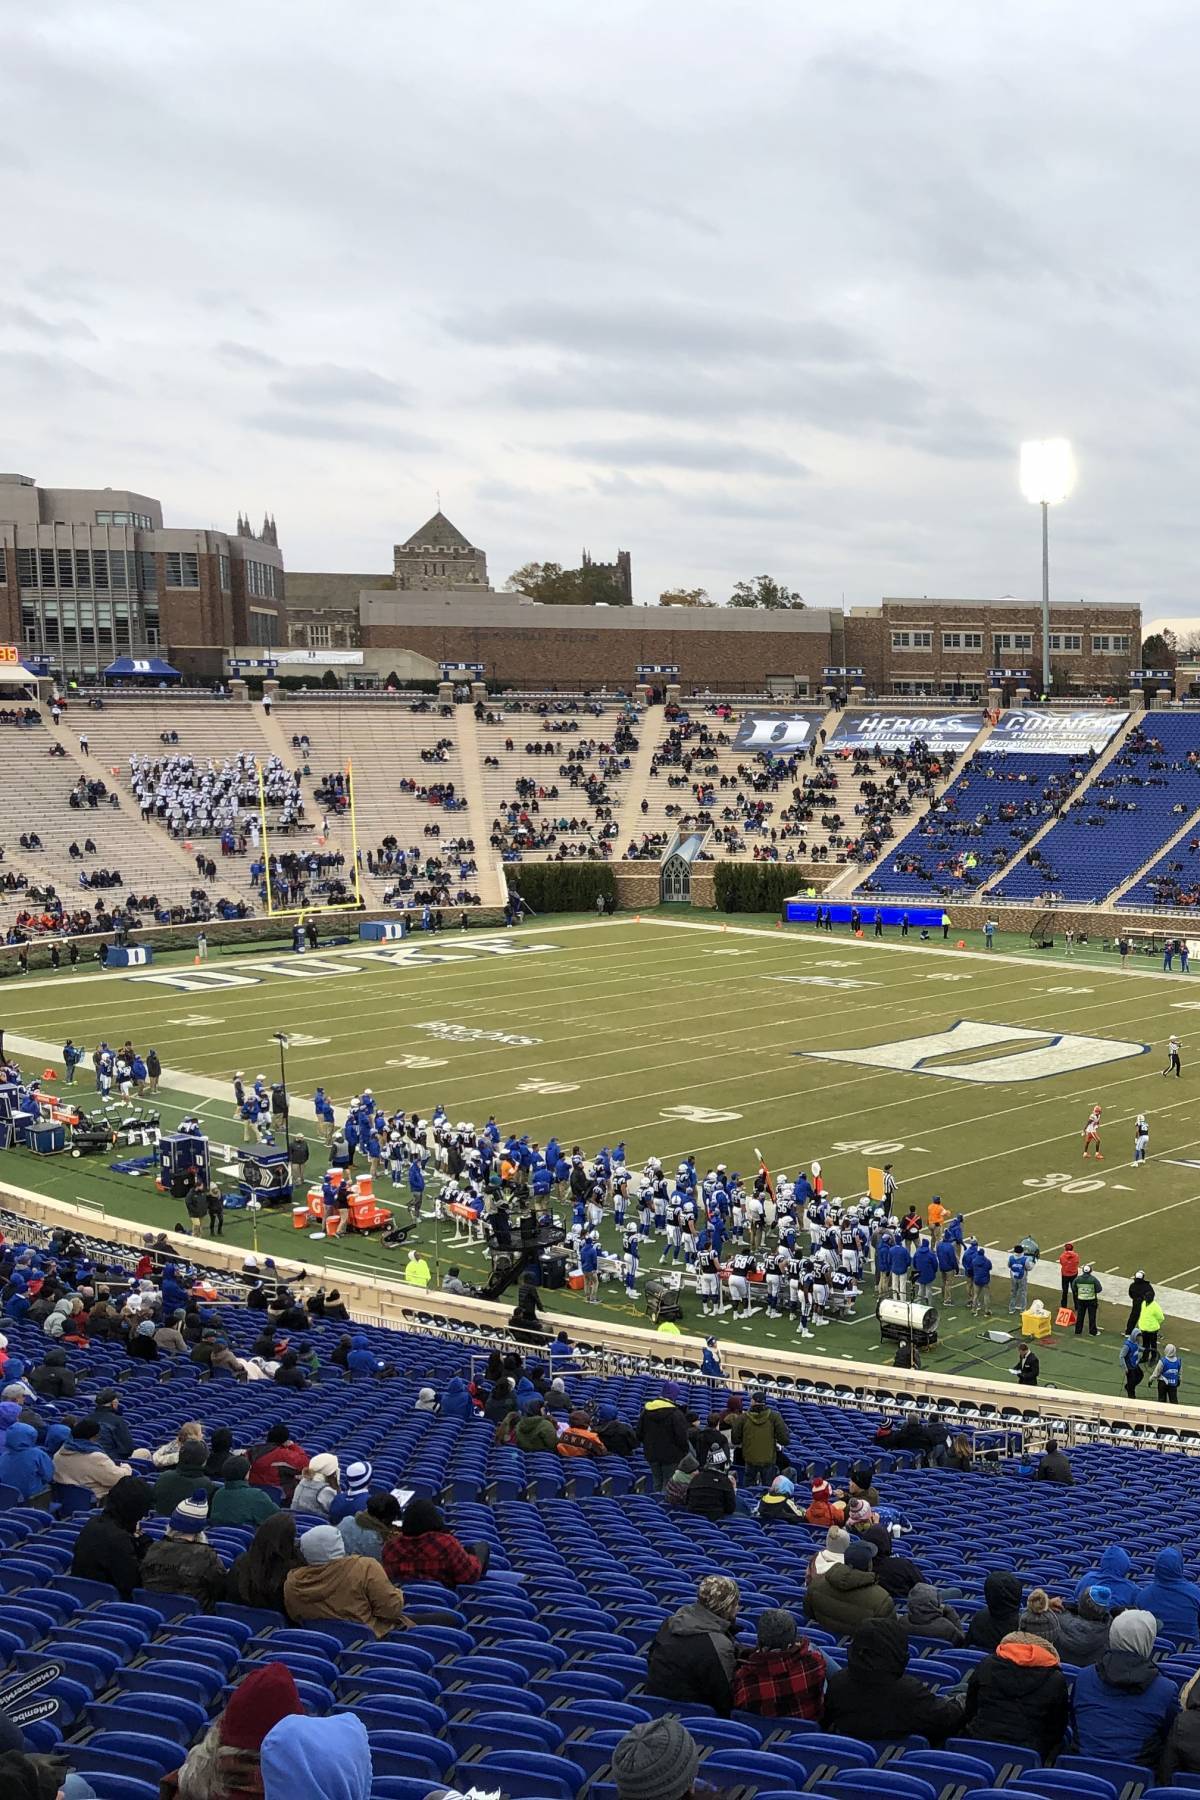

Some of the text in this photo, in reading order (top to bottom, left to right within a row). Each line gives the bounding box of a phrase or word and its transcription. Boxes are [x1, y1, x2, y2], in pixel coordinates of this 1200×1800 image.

[857, 718, 962, 732] HEROES
[1005, 717, 1110, 731] CORNER
[931, 733, 944, 741] &
[128, 939, 560, 992] DUKE
[409, 1021, 544, 1045] BROOKS
[831, 1139, 906, 1156] 40
[1022, 1172, 1107, 1194] 30
[842, 1234, 853, 1245] 60
[701, 1256, 710, 1266] 61
[735, 1254, 747, 1269] 68
[832, 1271, 847, 1285] 63
[1057, 1311, 1070, 1323] 20
[12, 1701, 54, 1723] #Membe
